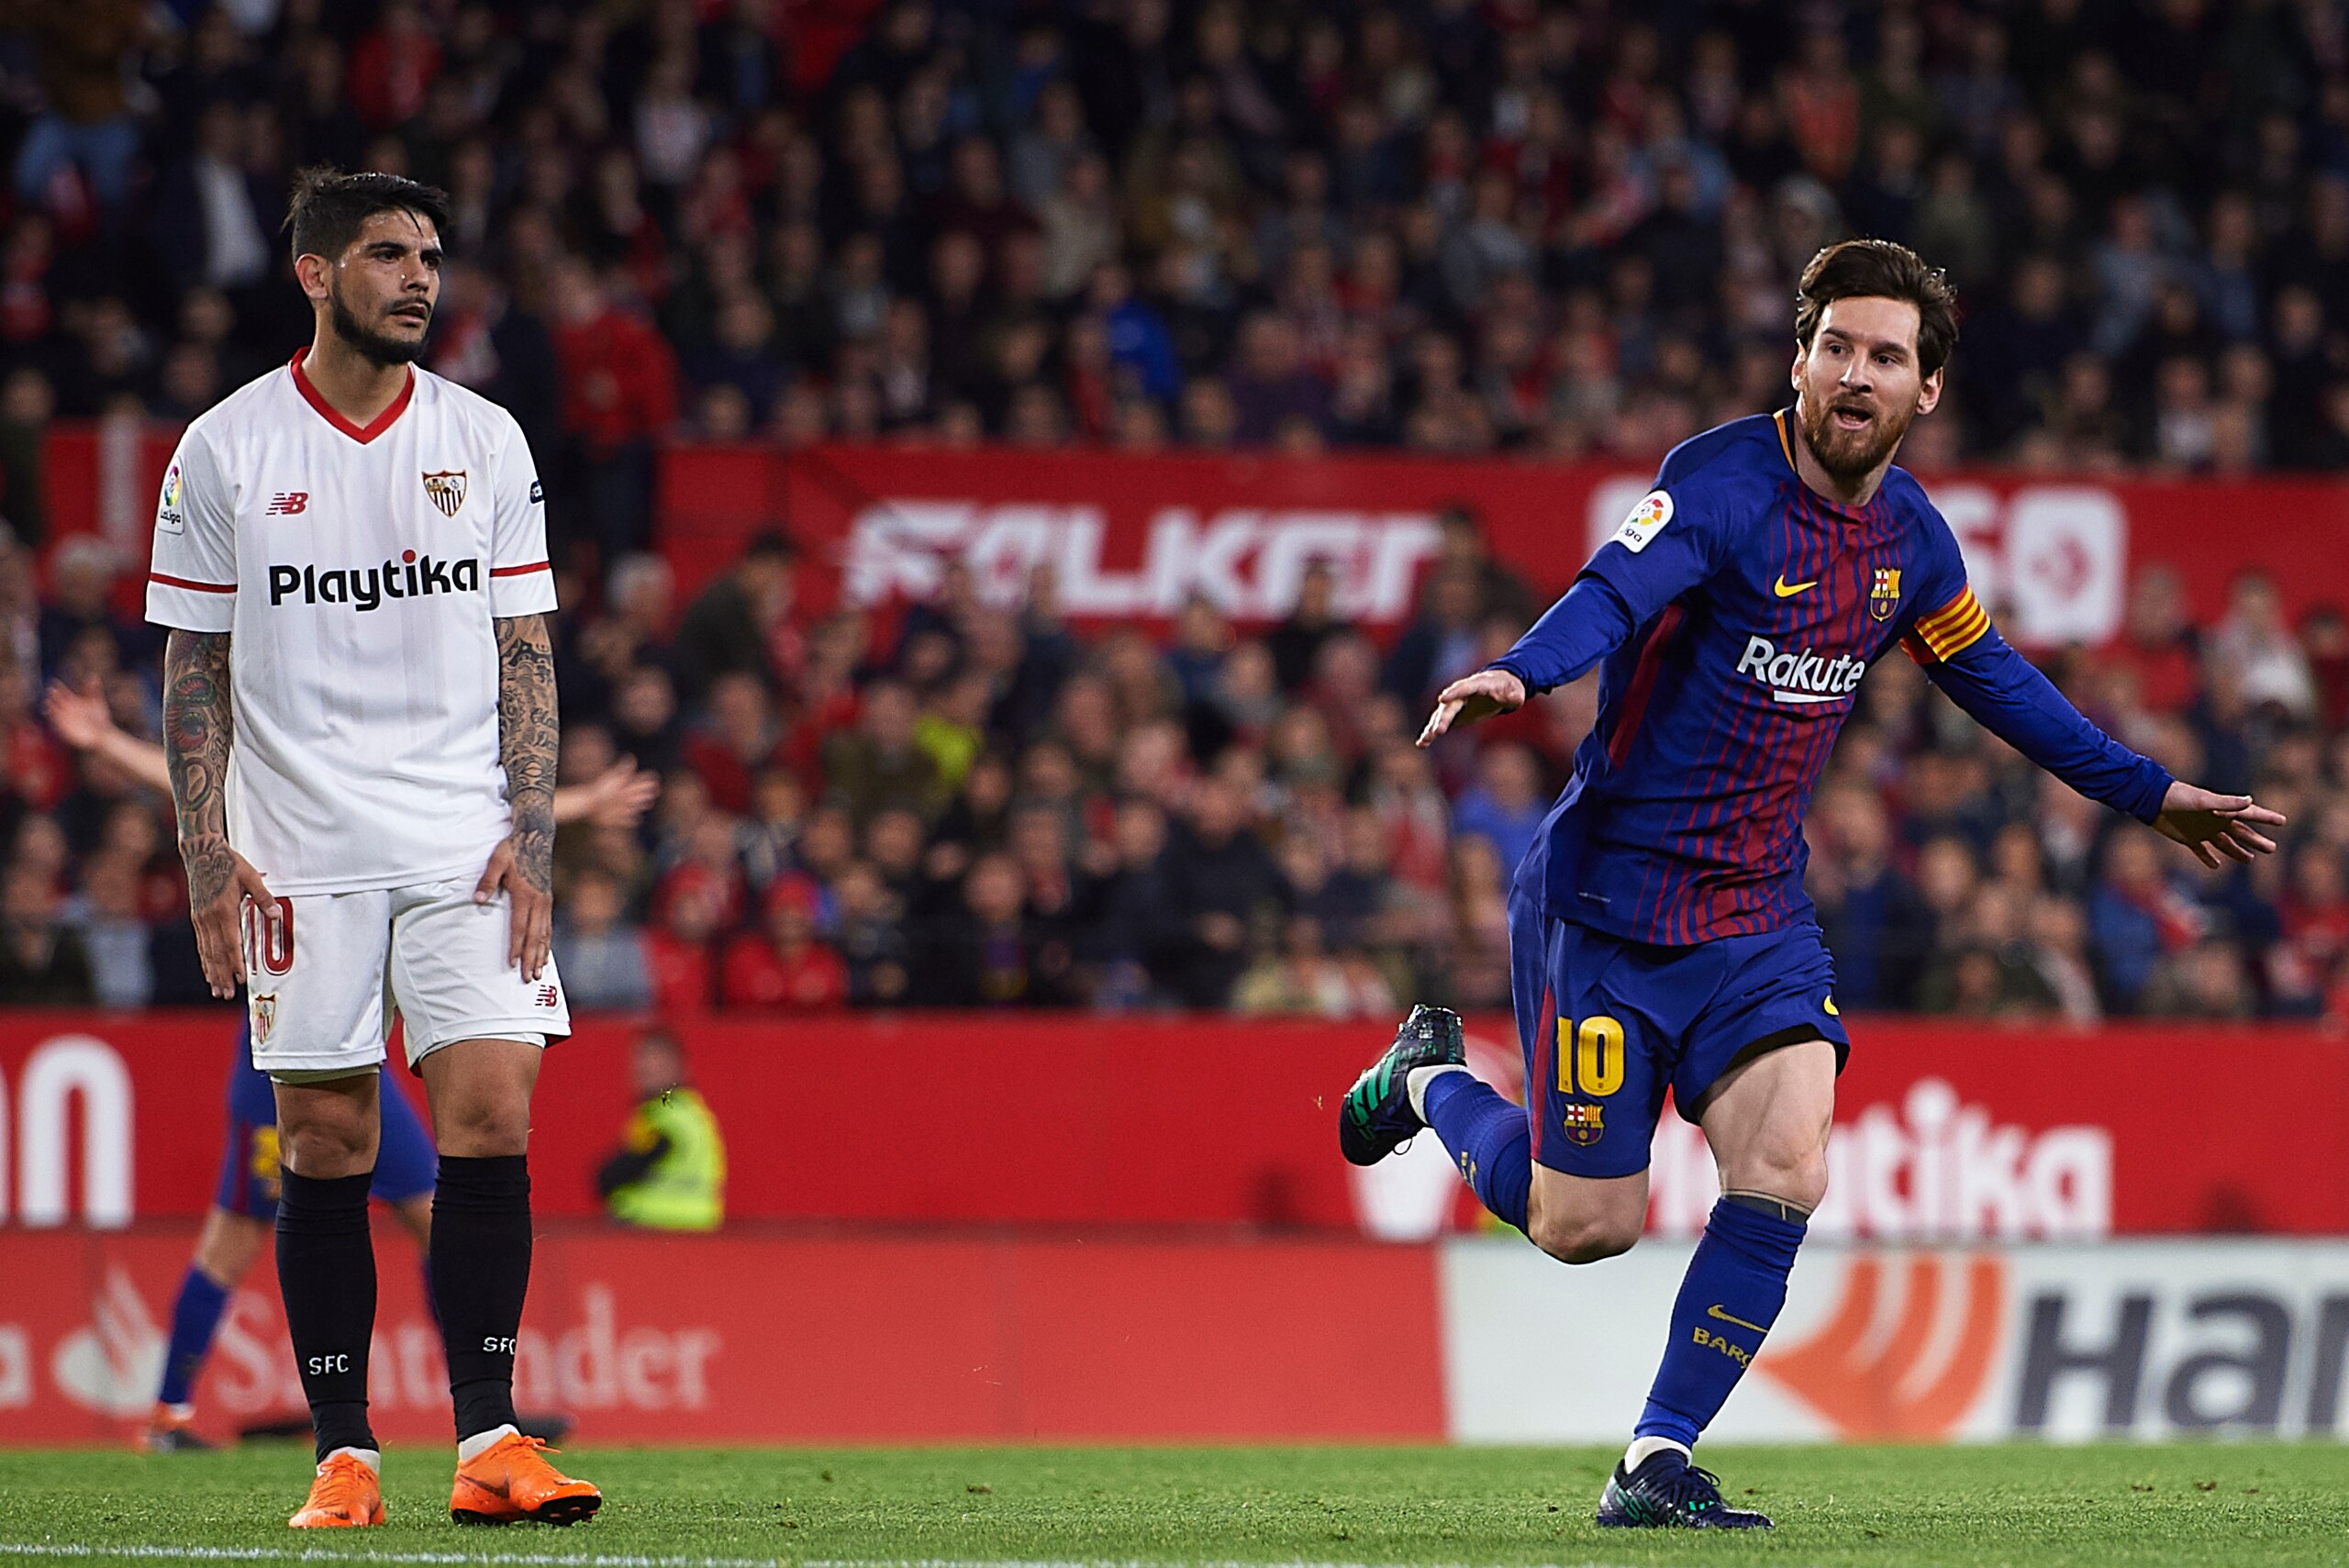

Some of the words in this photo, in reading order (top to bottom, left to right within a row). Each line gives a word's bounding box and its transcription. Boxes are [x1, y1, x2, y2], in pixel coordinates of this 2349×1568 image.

[269, 550, 478, 611] Playtika
[1557, 1016, 1624, 1096] 10
[308, 1354, 350, 1375] SFC
